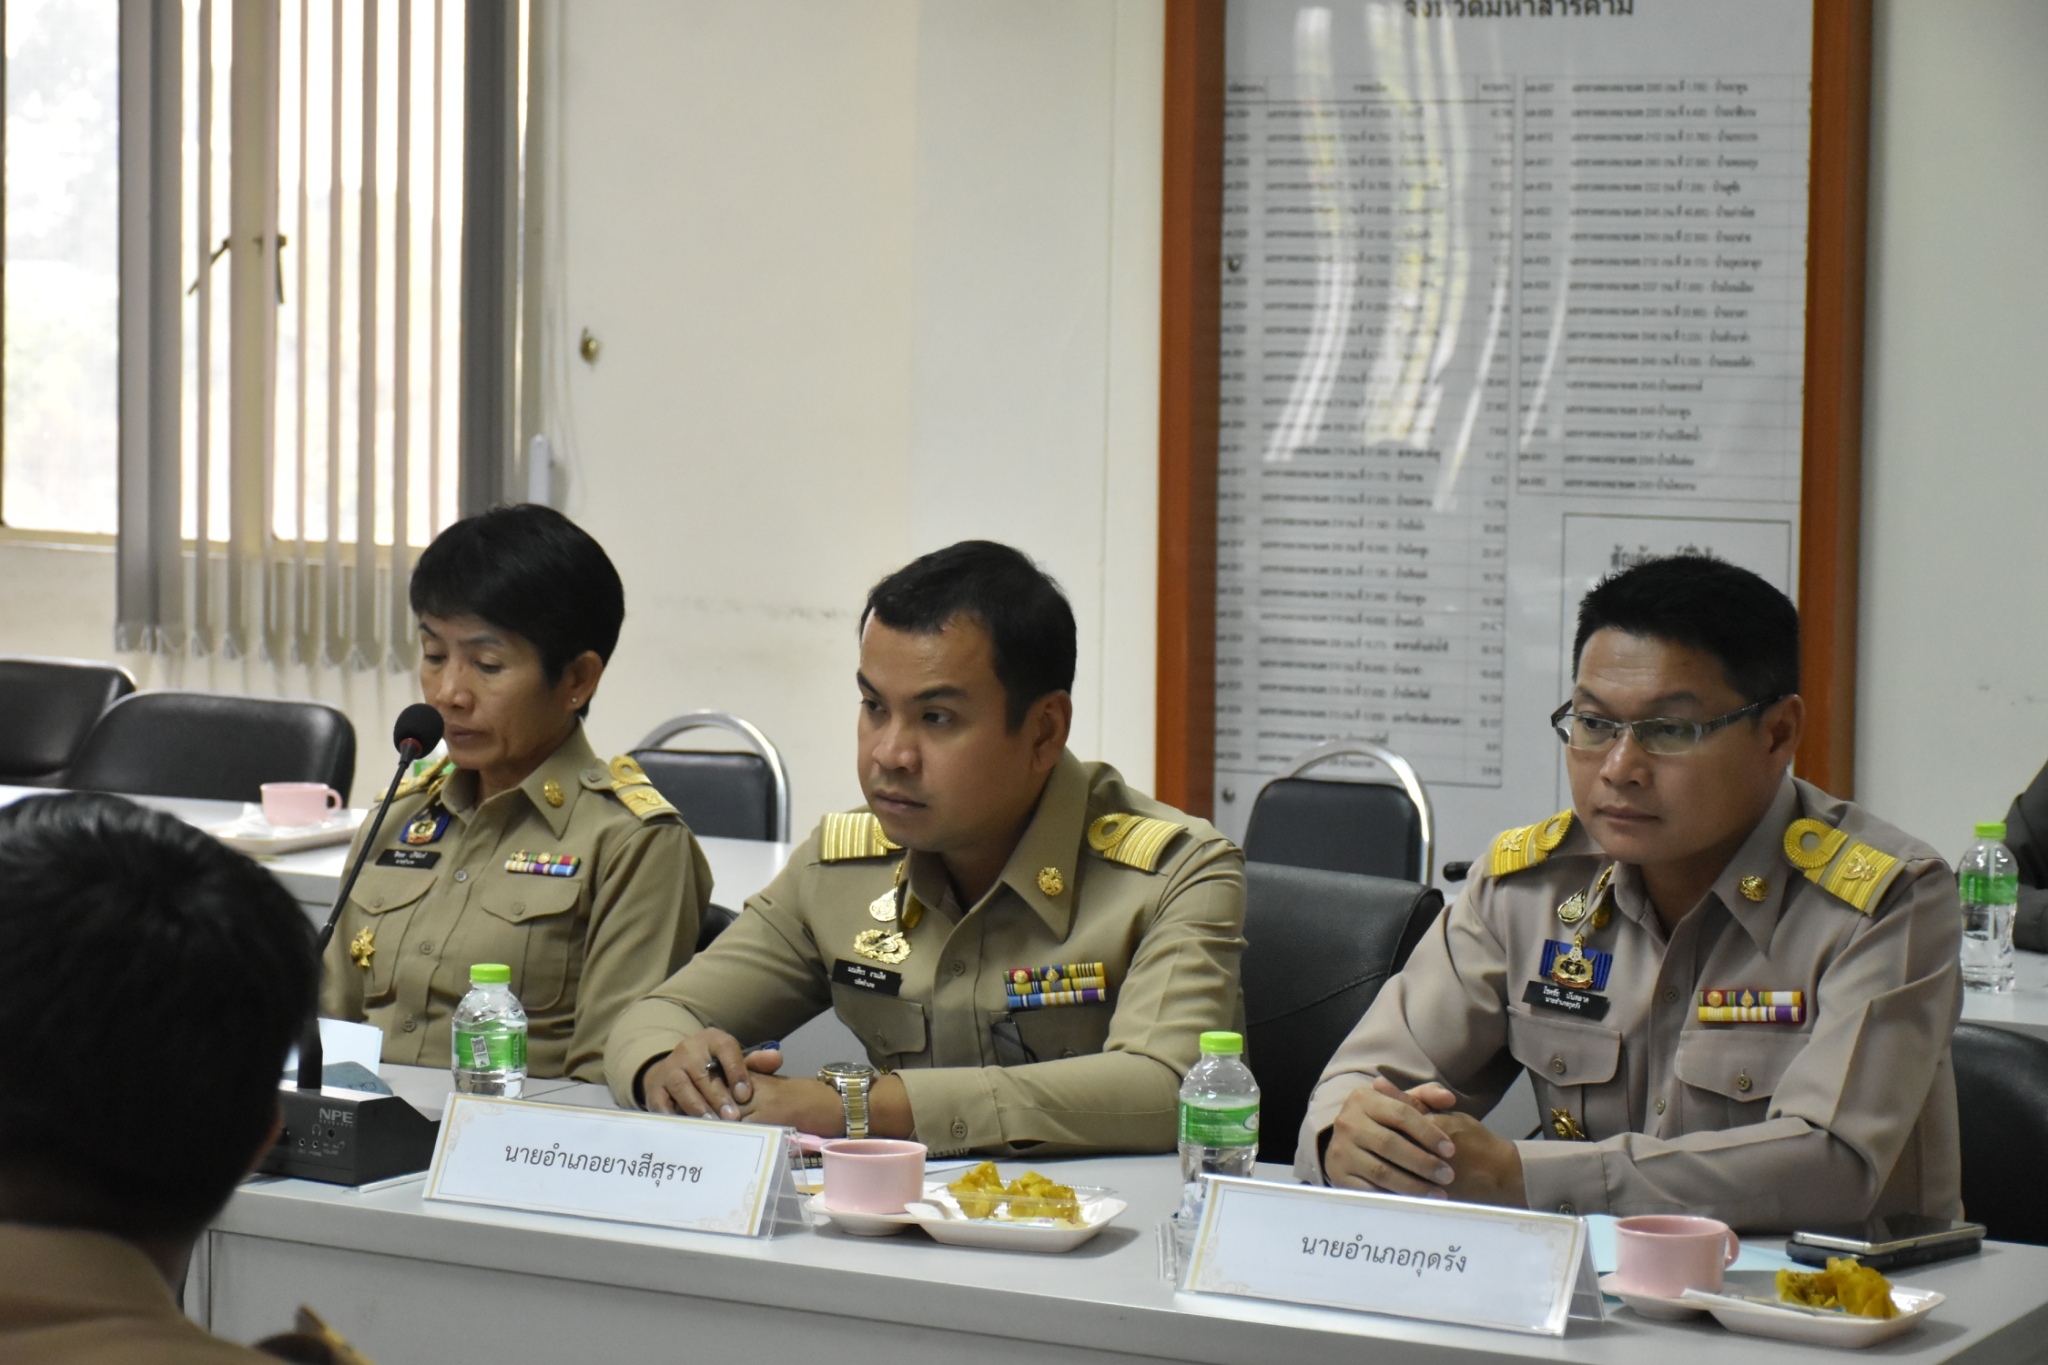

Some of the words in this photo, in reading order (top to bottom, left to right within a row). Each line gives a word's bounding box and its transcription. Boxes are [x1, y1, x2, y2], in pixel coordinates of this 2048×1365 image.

[319, 1107, 354, 1124] NPE
[504, 1142, 702, 1188] นายอำเภอยางสีสุราช
[1301, 1234, 1468, 1278] นายอำเภอกุดรัง
